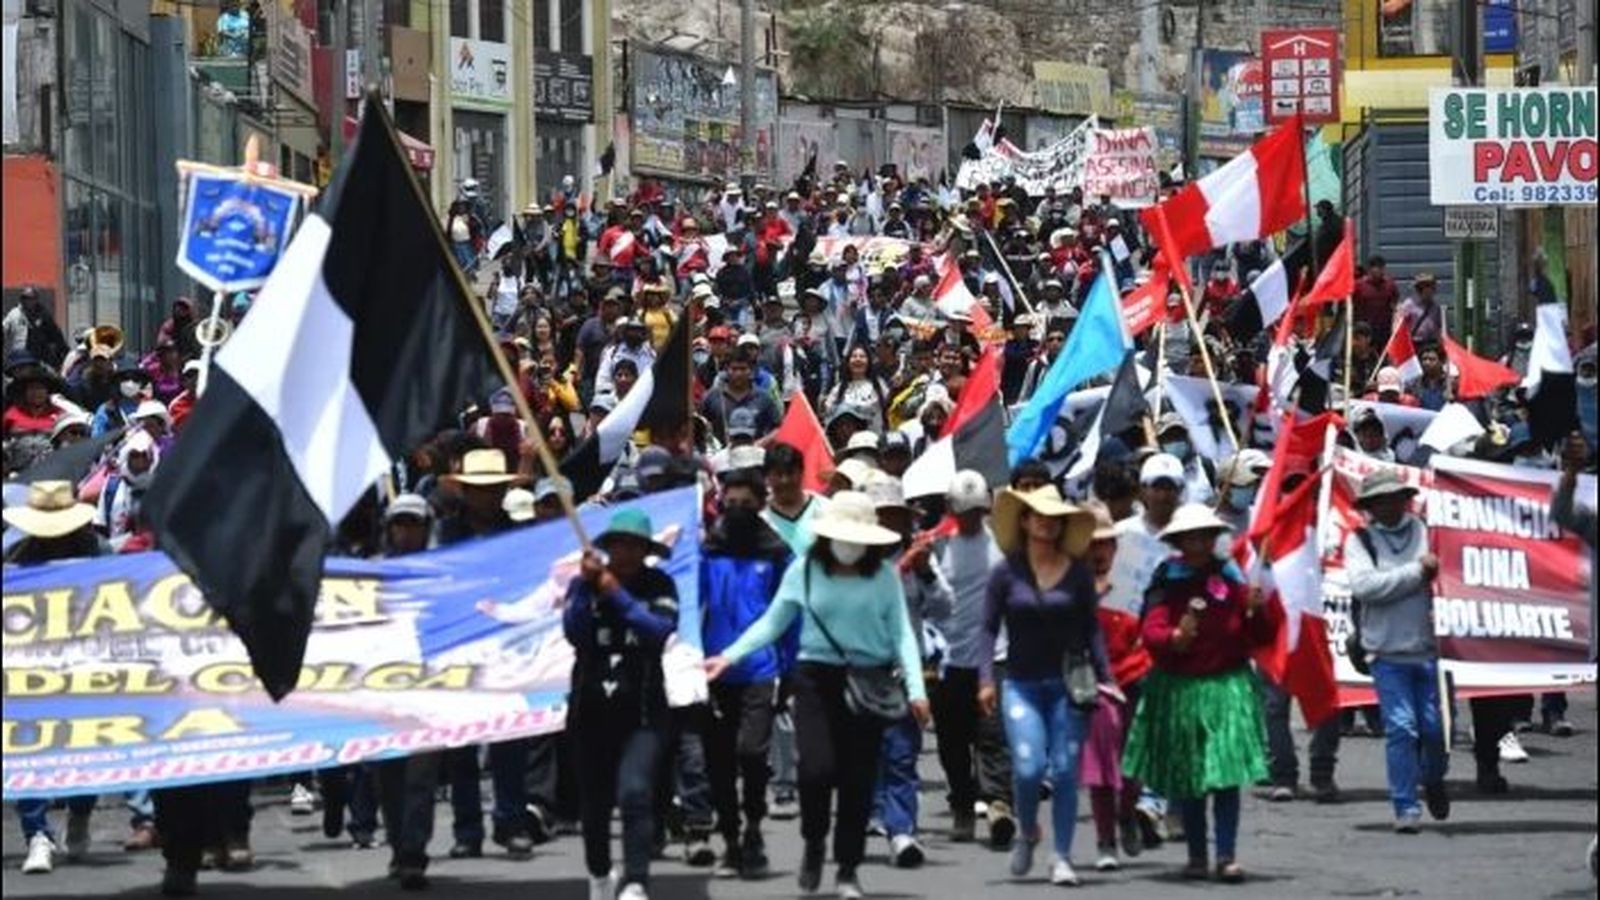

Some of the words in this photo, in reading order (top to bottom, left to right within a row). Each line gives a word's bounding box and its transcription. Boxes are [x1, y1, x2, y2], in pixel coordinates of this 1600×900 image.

[1443, 93, 1487, 139] SE
[1498, 91, 1596, 138] HORN
[1094, 130, 1152, 154] DINA
[1085, 155, 1157, 176] ASESINA
[1474, 139, 1597, 182] PAVO
[1474, 186, 1514, 202] Cel:
[1462, 546, 1530, 590] DINA
[1433, 597, 1574, 640] BOLUARTE
[5, 667, 174, 695] DEL
